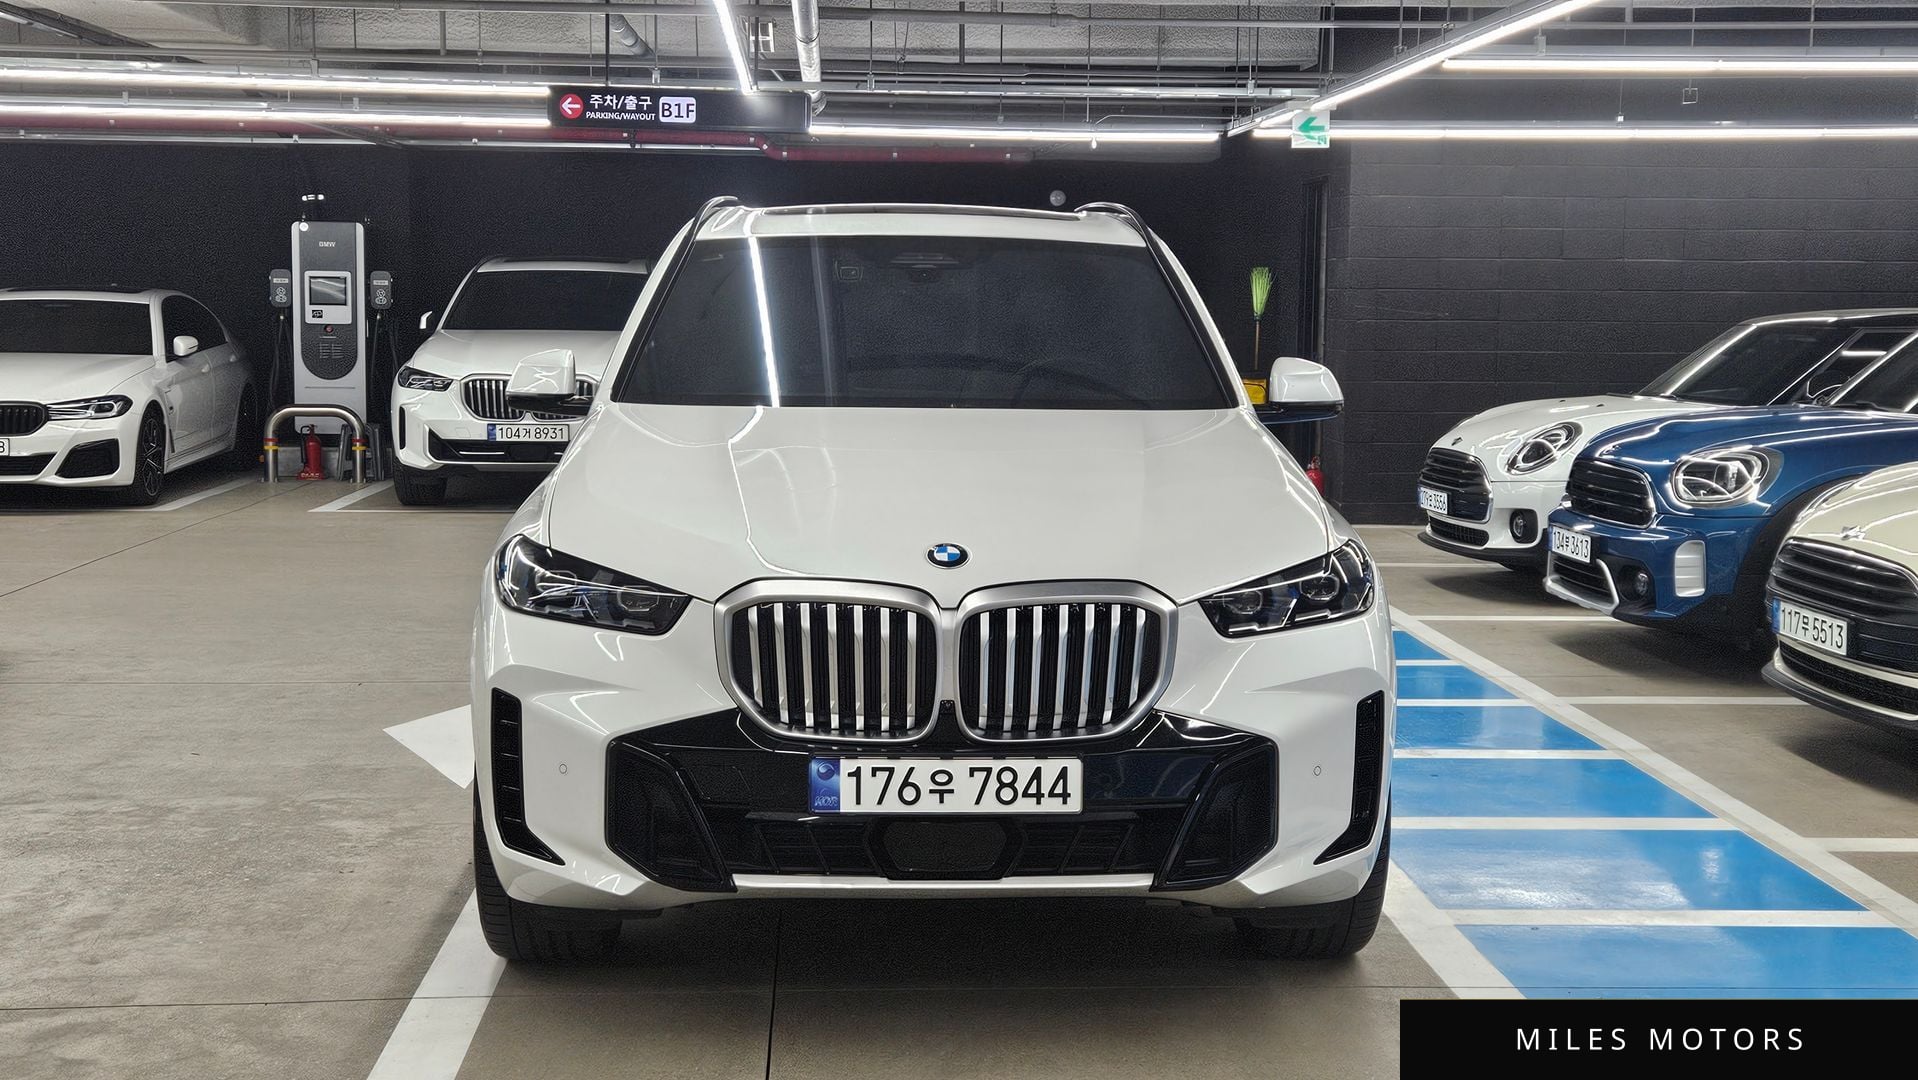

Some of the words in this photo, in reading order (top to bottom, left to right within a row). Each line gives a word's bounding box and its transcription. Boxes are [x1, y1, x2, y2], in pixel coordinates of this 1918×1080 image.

[589, 94, 653, 110] 주차/출구
[661, 102, 695, 119] B1F
[585, 111, 656, 121] PARKING/WAYOUT
[498, 427, 531, 439] 104거
[534, 427, 564, 439] 8931
[1571, 535, 1589, 558] 3613
[1812, 617, 1844, 649] 5513
[847, 765, 955, 806] 176우
[968, 765, 1072, 806] 7844
